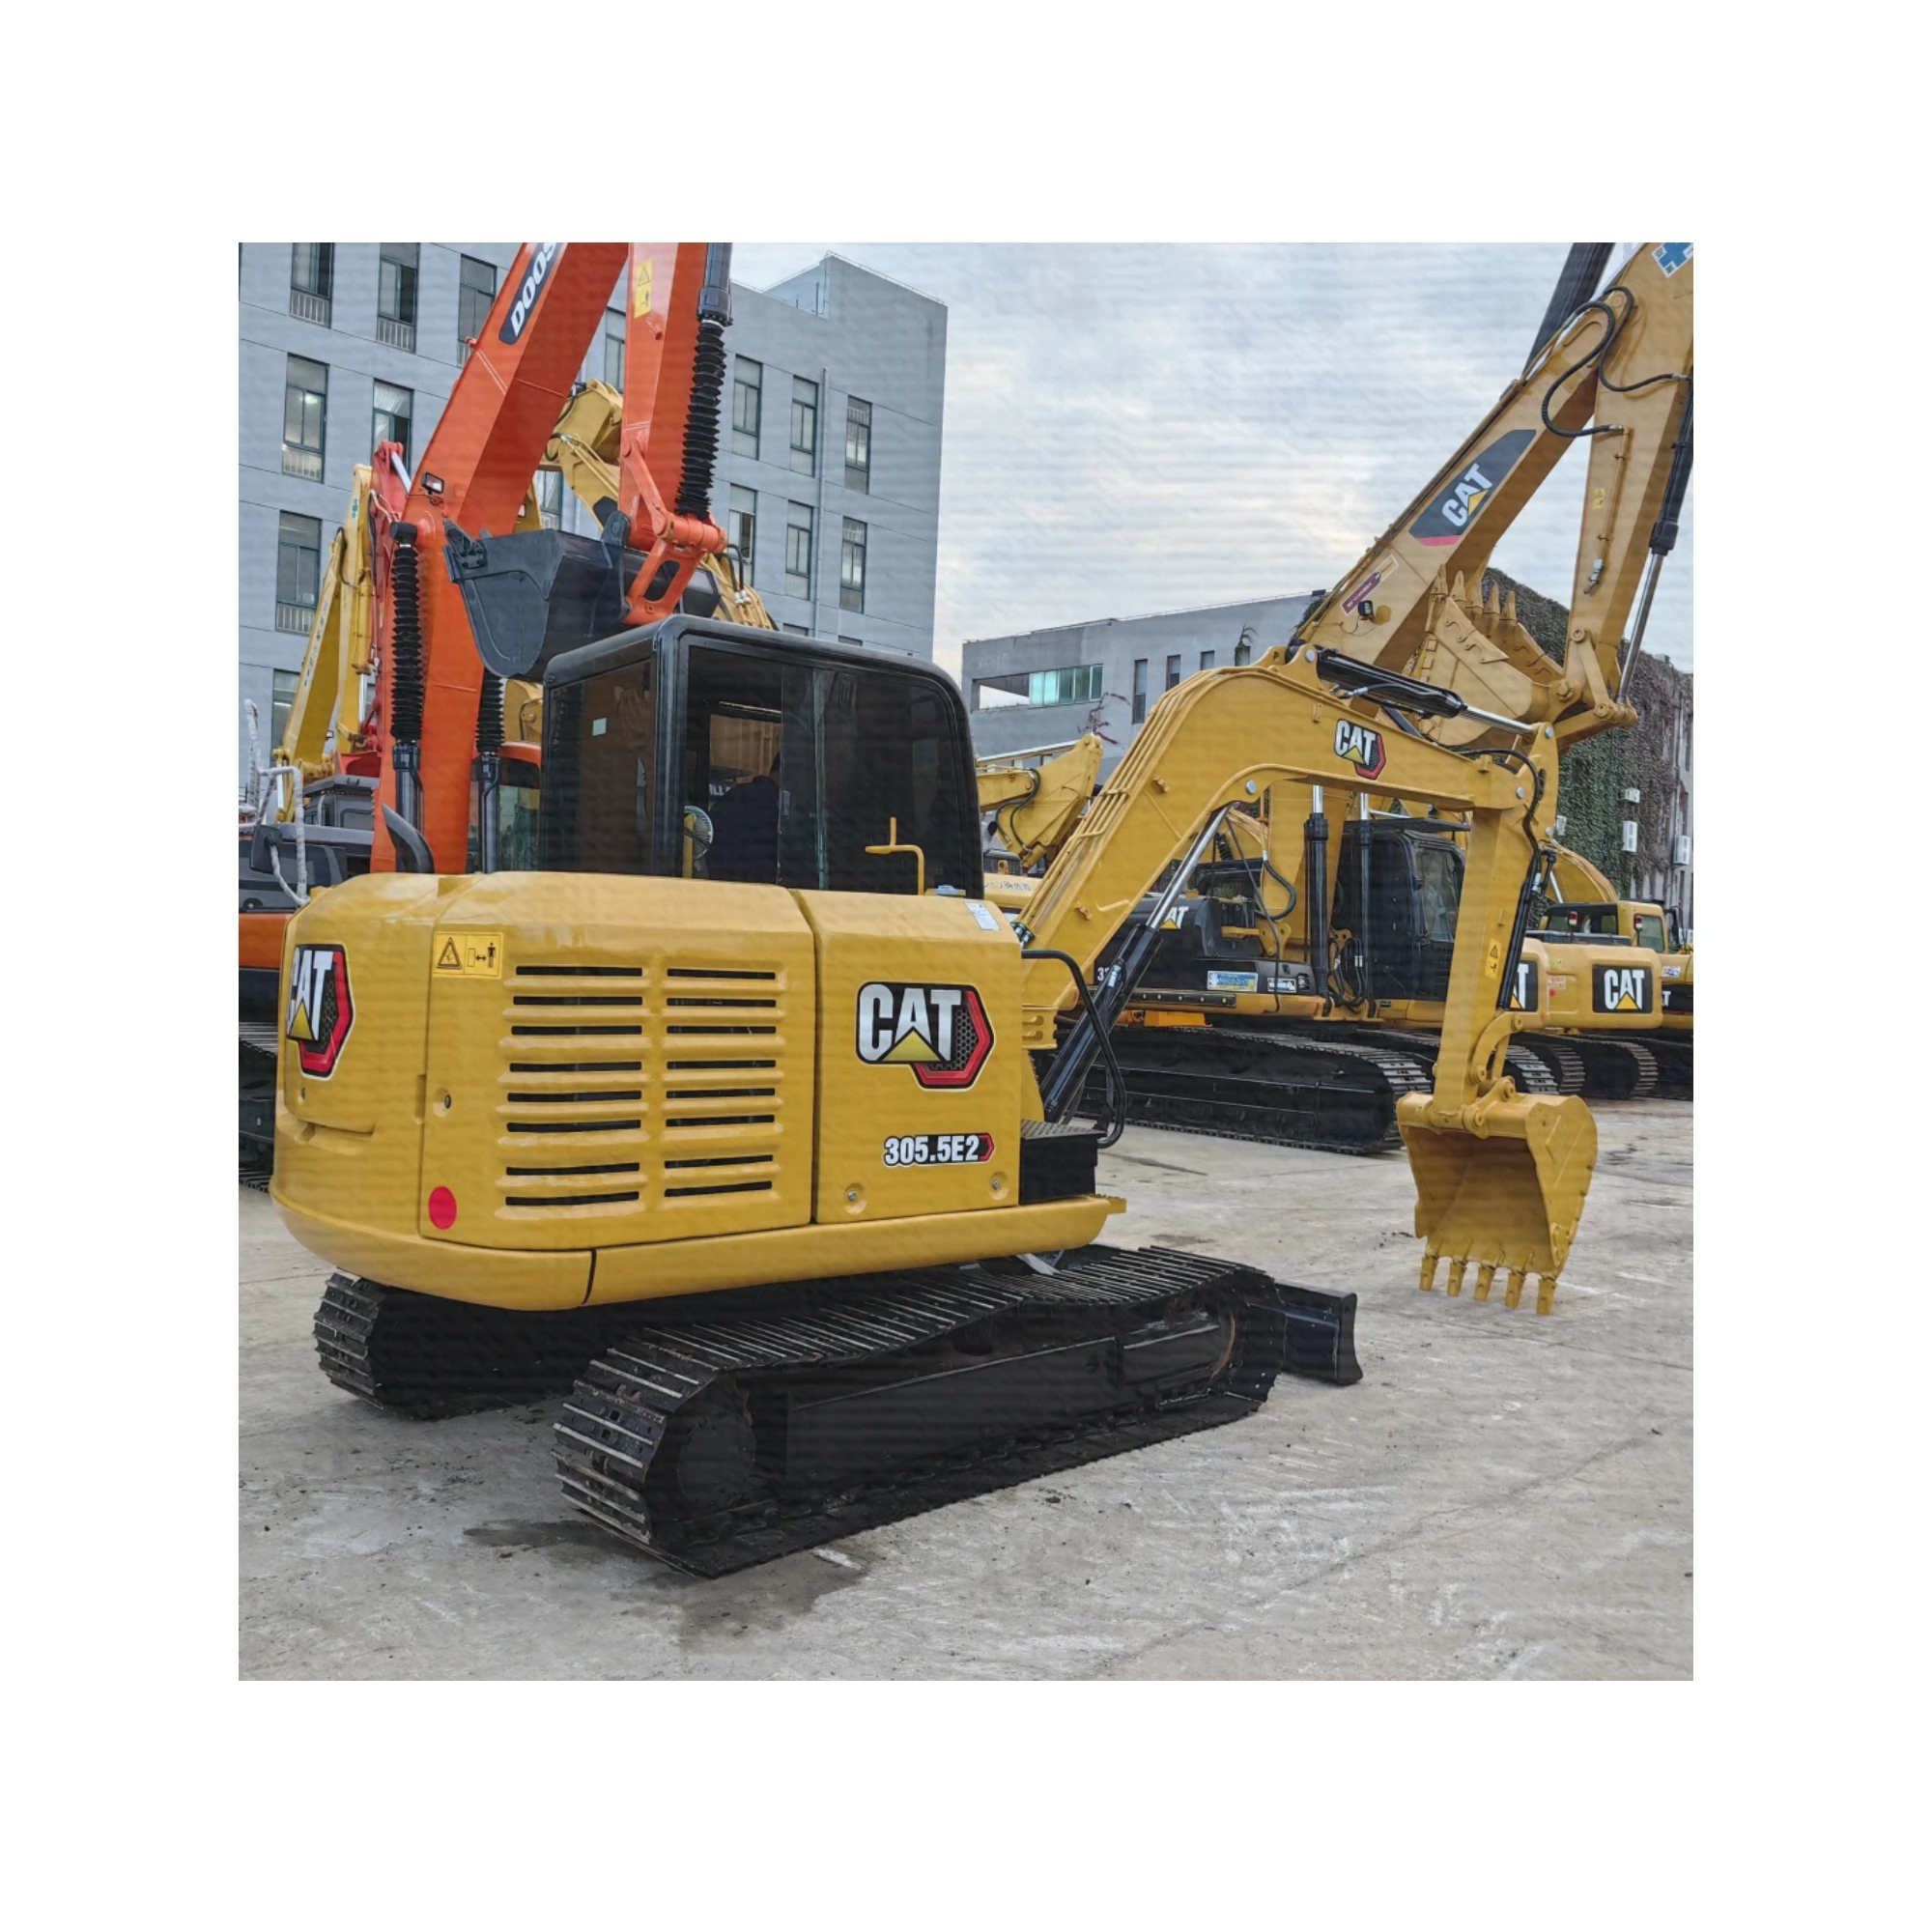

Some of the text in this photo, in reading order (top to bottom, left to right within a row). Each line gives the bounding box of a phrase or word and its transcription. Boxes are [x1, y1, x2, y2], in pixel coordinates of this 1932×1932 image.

[1441, 463, 1493, 526] CAT
[1334, 720, 1377, 766] CAT
[1163, 906, 1189, 929] AT
[1604, 969, 1645, 1010] CAT
[859, 983, 962, 1062] CAT
[884, 1134, 980, 1165] 305.5E2
